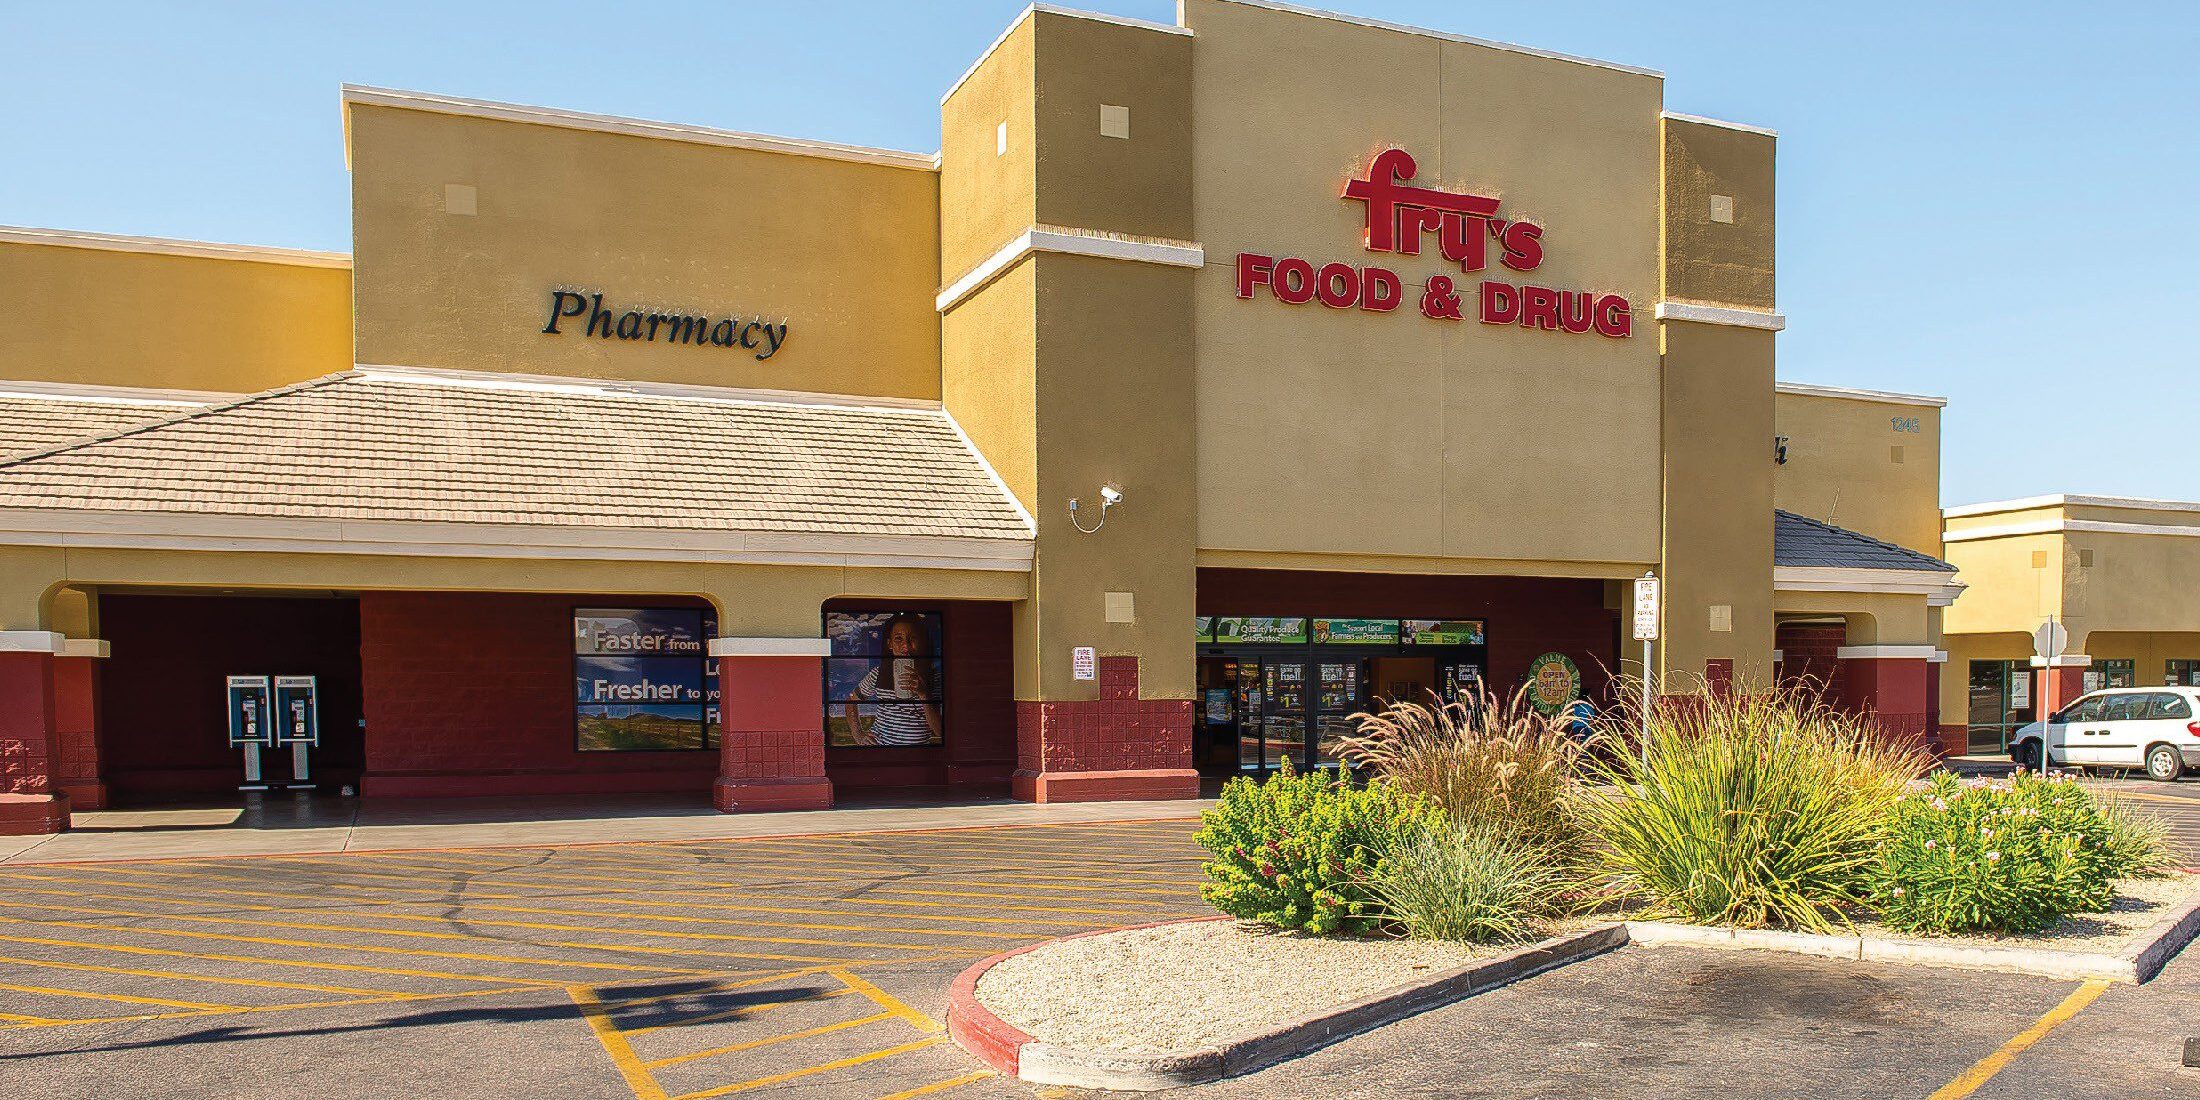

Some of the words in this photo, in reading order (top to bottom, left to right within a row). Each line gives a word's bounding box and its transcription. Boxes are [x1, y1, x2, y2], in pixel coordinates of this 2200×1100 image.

[1340, 149, 1545, 273] fry's
[1236, 252, 1402, 312] FOOD
[1421, 275, 1467, 321] &
[1480, 281, 1633, 338] DRUG
[542, 291, 788, 361] Pharmacy
[1890, 416, 1921, 434] 1245
[1240, 633, 1281, 643] Guarantee
[1368, 624, 1384, 632] Local
[594, 630, 666, 651] Faster
[668, 638, 701, 651] from
[1542, 671, 1566, 679] OPEN
[594, 678, 682, 700] Fresher
[686, 688, 701, 699] to
